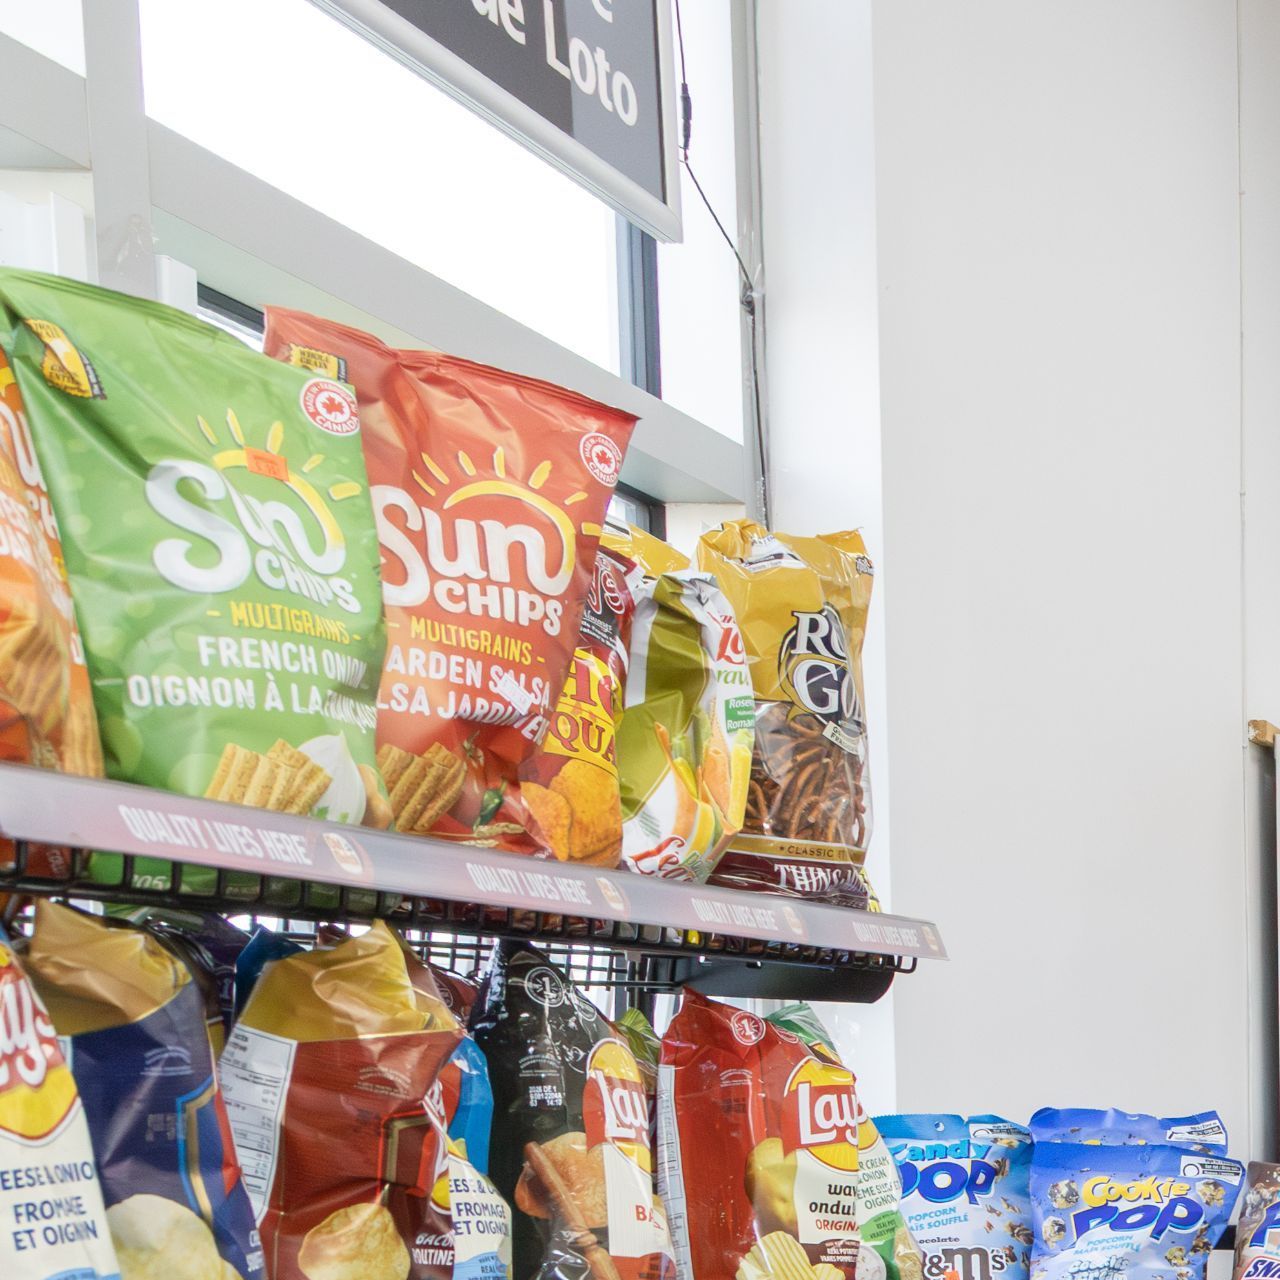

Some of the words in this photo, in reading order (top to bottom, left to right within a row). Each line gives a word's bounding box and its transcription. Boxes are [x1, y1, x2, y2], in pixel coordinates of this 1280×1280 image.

[544, 0, 638, 126] Loto
[375, 484, 566, 607] Sun
[255, 552, 361, 613] CHIPS
[230, 601, 351, 644] MULTIGRAINS
[433, 582, 562, 635] CHIPS
[199, 636, 317, 673] FRENCH
[411, 616, 532, 666] MULTIGRAINS
[386, 643, 482, 690] ARDEN
[128, 675, 255, 710] OIGNON
[265, 676, 284, 712] À
[119, 805, 199, 846] QUALITY
[206, 821, 260, 859] LIVES
[263, 832, 312, 865] HERE
[787, 843, 834, 858] CLASSIC
[467, 862, 523, 894] QUALITY
[526, 870, 559, 899] LIVES
[562, 878, 591, 904] HERE
[604, 1071, 646, 1139] Lay
[800, 1082, 858, 1146] Lay
[809, 1198, 856, 1216] ondul
[1082, 1176, 1191, 1207] Cookie
[815, 1219, 860, 1232] ORIGINA
[908, 1206, 957, 1223] POPCORN
[14, 1231, 36, 1251] ET
